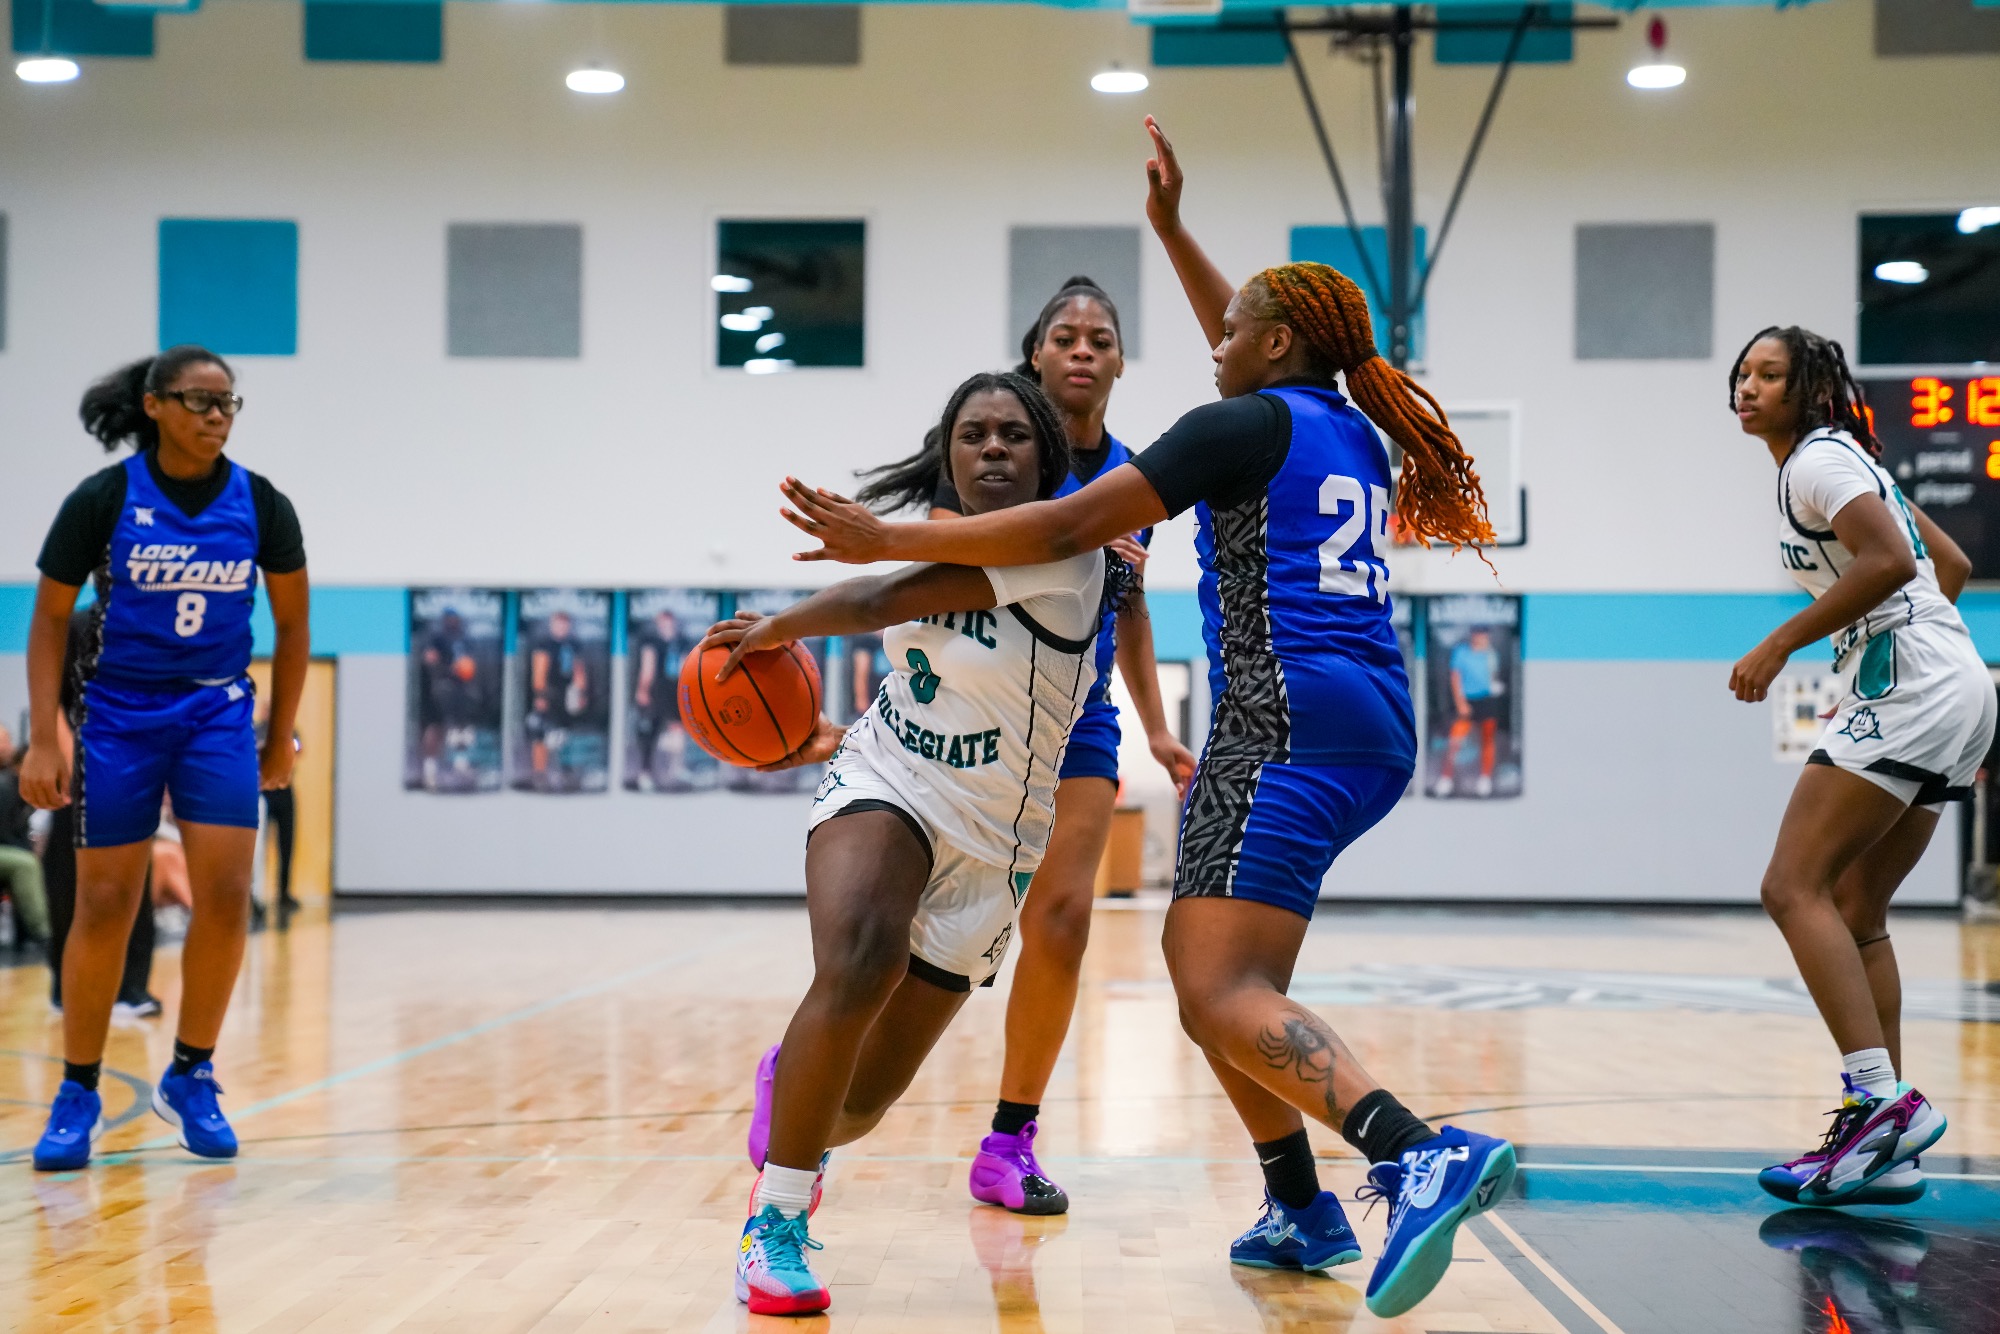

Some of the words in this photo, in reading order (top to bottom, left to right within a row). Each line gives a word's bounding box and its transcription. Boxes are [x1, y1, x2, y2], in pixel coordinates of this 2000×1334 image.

[1911, 377, 2000, 428] 3:12
[129, 543, 198, 561] LADY
[126, 559, 253, 585] TITANS
[174, 592, 208, 638] 8
